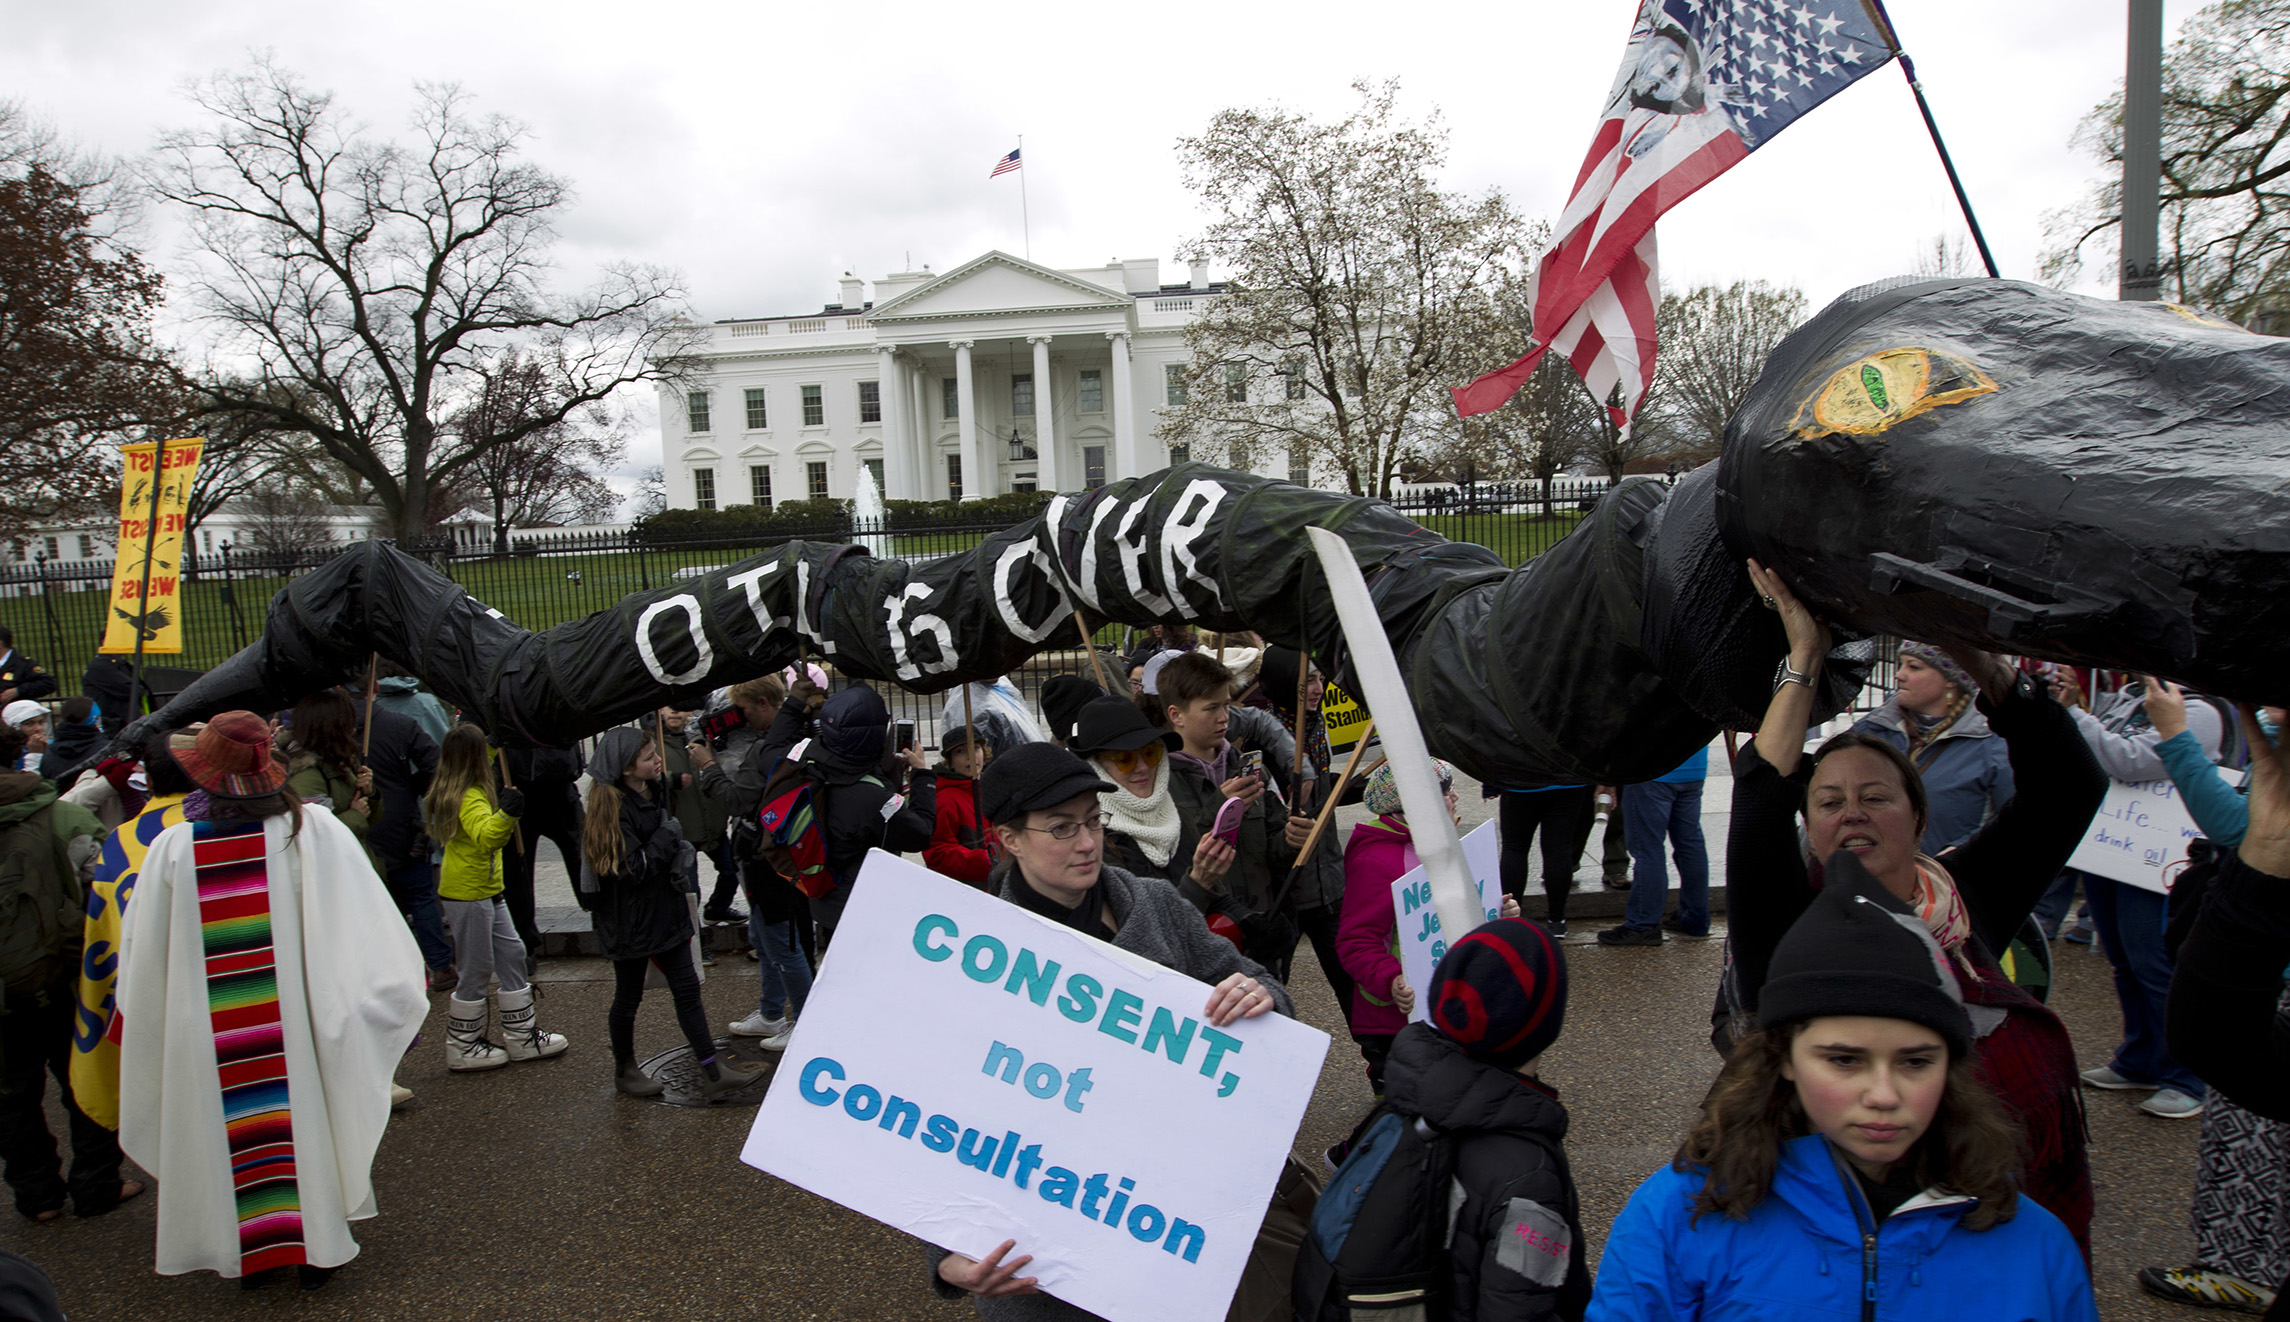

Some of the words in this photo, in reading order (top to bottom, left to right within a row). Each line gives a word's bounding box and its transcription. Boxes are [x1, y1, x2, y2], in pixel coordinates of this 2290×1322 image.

[994, 479, 1234, 643] OVER
[1324, 687, 1349, 708] We
[2094, 827, 2134, 852] drink
[2144, 847, 2168, 864] oil
[912, 914, 1243, 1099] CONSENT,
[981, 1040, 1094, 1114] not
[798, 1056, 1206, 1265] Consultation
